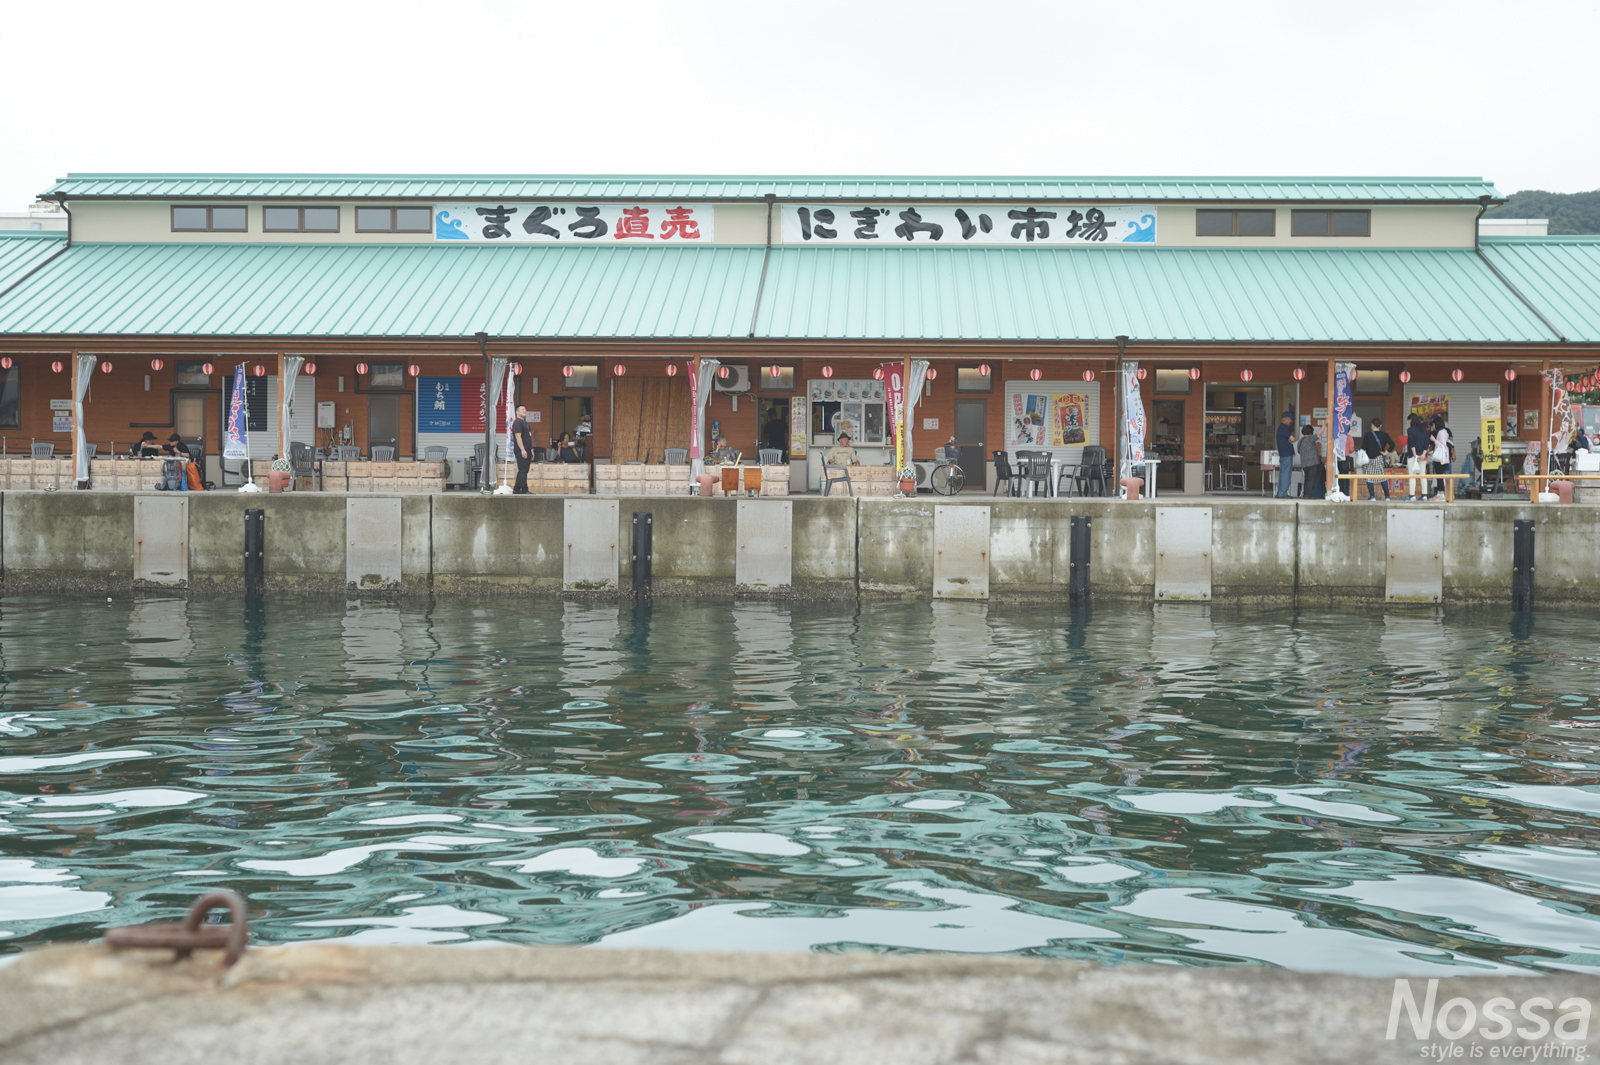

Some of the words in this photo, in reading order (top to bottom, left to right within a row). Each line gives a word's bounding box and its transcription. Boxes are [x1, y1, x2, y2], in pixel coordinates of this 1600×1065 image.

[476, 204, 700, 240] まぐろ直売
[797, 206, 1117, 242] にぎわい市場
